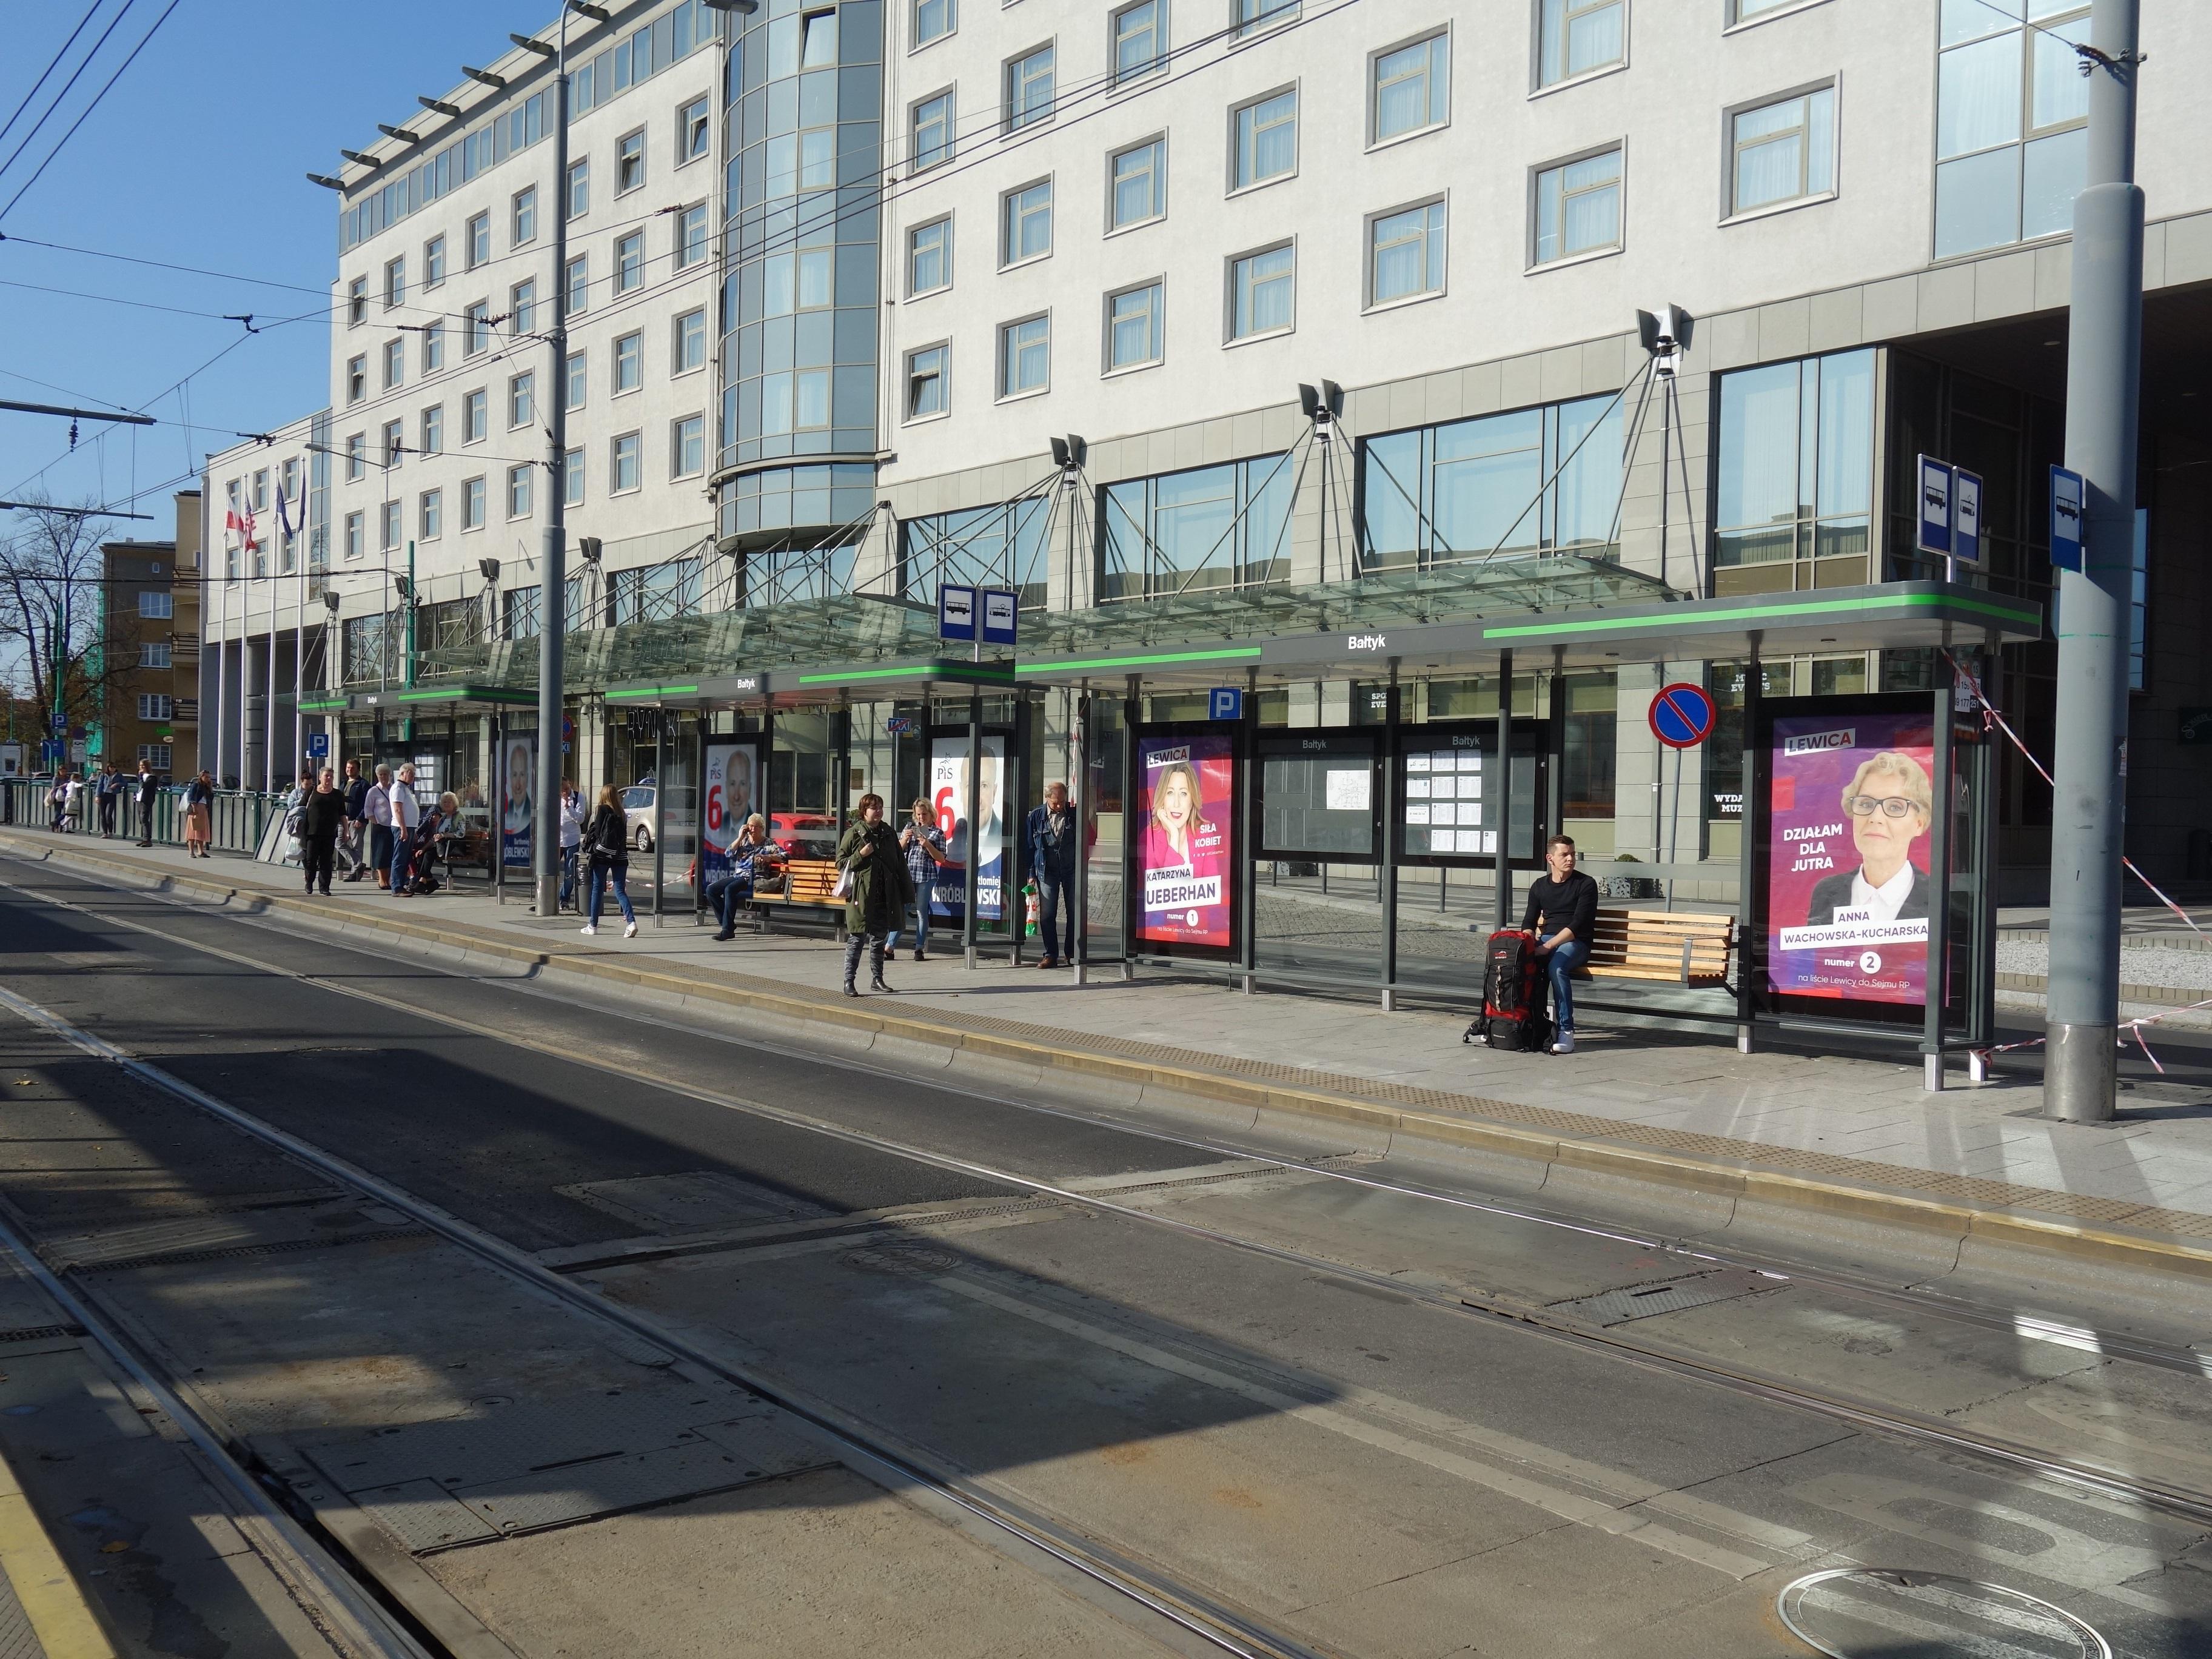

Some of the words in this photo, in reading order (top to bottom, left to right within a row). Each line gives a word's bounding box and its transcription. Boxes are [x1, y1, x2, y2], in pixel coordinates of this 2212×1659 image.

[1348, 634, 1386, 651] Bałtyk
[737, 678, 756, 689] Bałtyk
[1216, 691, 1234, 717] P
[627, 708, 676, 739] RYNK
[889, 719, 910, 731] TAXI
[313, 736, 325, 751] P
[1302, 739, 1327, 751] Bałtyk
[1452, 735, 1480, 748] Bałtyk
[1789, 732, 1852, 752] LEWICA
[1148, 748, 1187, 765] LEWICA
[710, 769, 722, 780] PiS
[937, 768, 953, 780] PiS
[1714, 794, 1743, 803] WYDA
[708, 785, 722, 831] 6
[935, 786, 955, 841] 6
[1721, 804, 1743, 813] MUZ
[1199, 823, 1216, 834] SIŁA
[1783, 823, 1843, 842] DZIAŁAM
[1195, 836, 1221, 848] KOBIET
[1800, 841, 1826, 856] DLA
[1791, 856, 1834, 872] JUTRA
[1147, 868, 1191, 882] KATARZYNA
[977, 876, 1000, 889] tłomiej
[1146, 883, 1216, 905] UEBERHAN
[1838, 911, 1869, 922] ANNA
[1785, 925, 1928, 943] WACHOWSKA-KUCHARSKA
[1824, 958, 1855, 968] numer
[1866, 956, 1875, 968] 2
[1810, 974, 1829, 984] liście
[1830, 976, 1857, 987] Lewicy
[1872, 979, 1897, 989] Sejmu
[1899, 980, 1910, 989] RP
